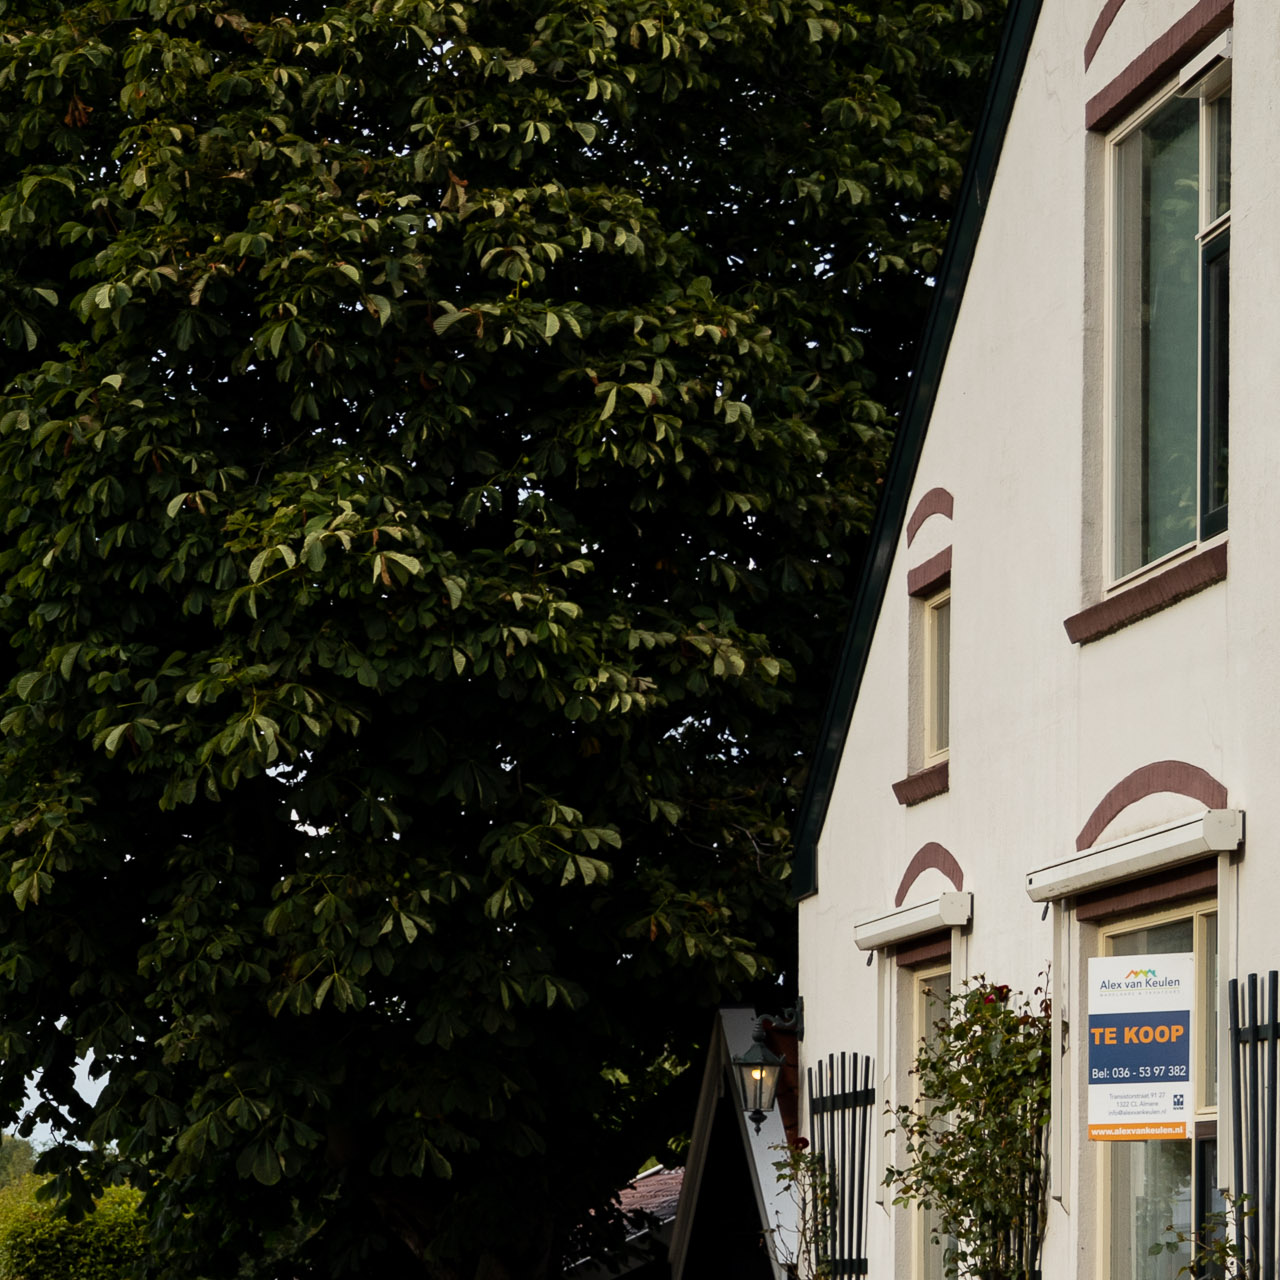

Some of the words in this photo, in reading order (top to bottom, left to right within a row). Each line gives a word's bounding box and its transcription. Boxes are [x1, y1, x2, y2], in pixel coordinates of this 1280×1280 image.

[1100, 979, 1122, 990] Alex
[1124, 981, 1142, 989] van
[1145, 977, 1180, 988] Keulen
[1091, 1027, 1117, 1045] TE
[1124, 1025, 1184, 1044] KOOP
[1092, 1068, 1110, 1079] Bel:
[1112, 1067, 1130, 1078] 036
[1139, 1066, 1151, 1077] 53
[1153, 1066, 1165, 1077] 97
[1168, 1065, 1186, 1076] 382
[1091, 1126, 1183, 1136] www.alexvankeulen.nl
